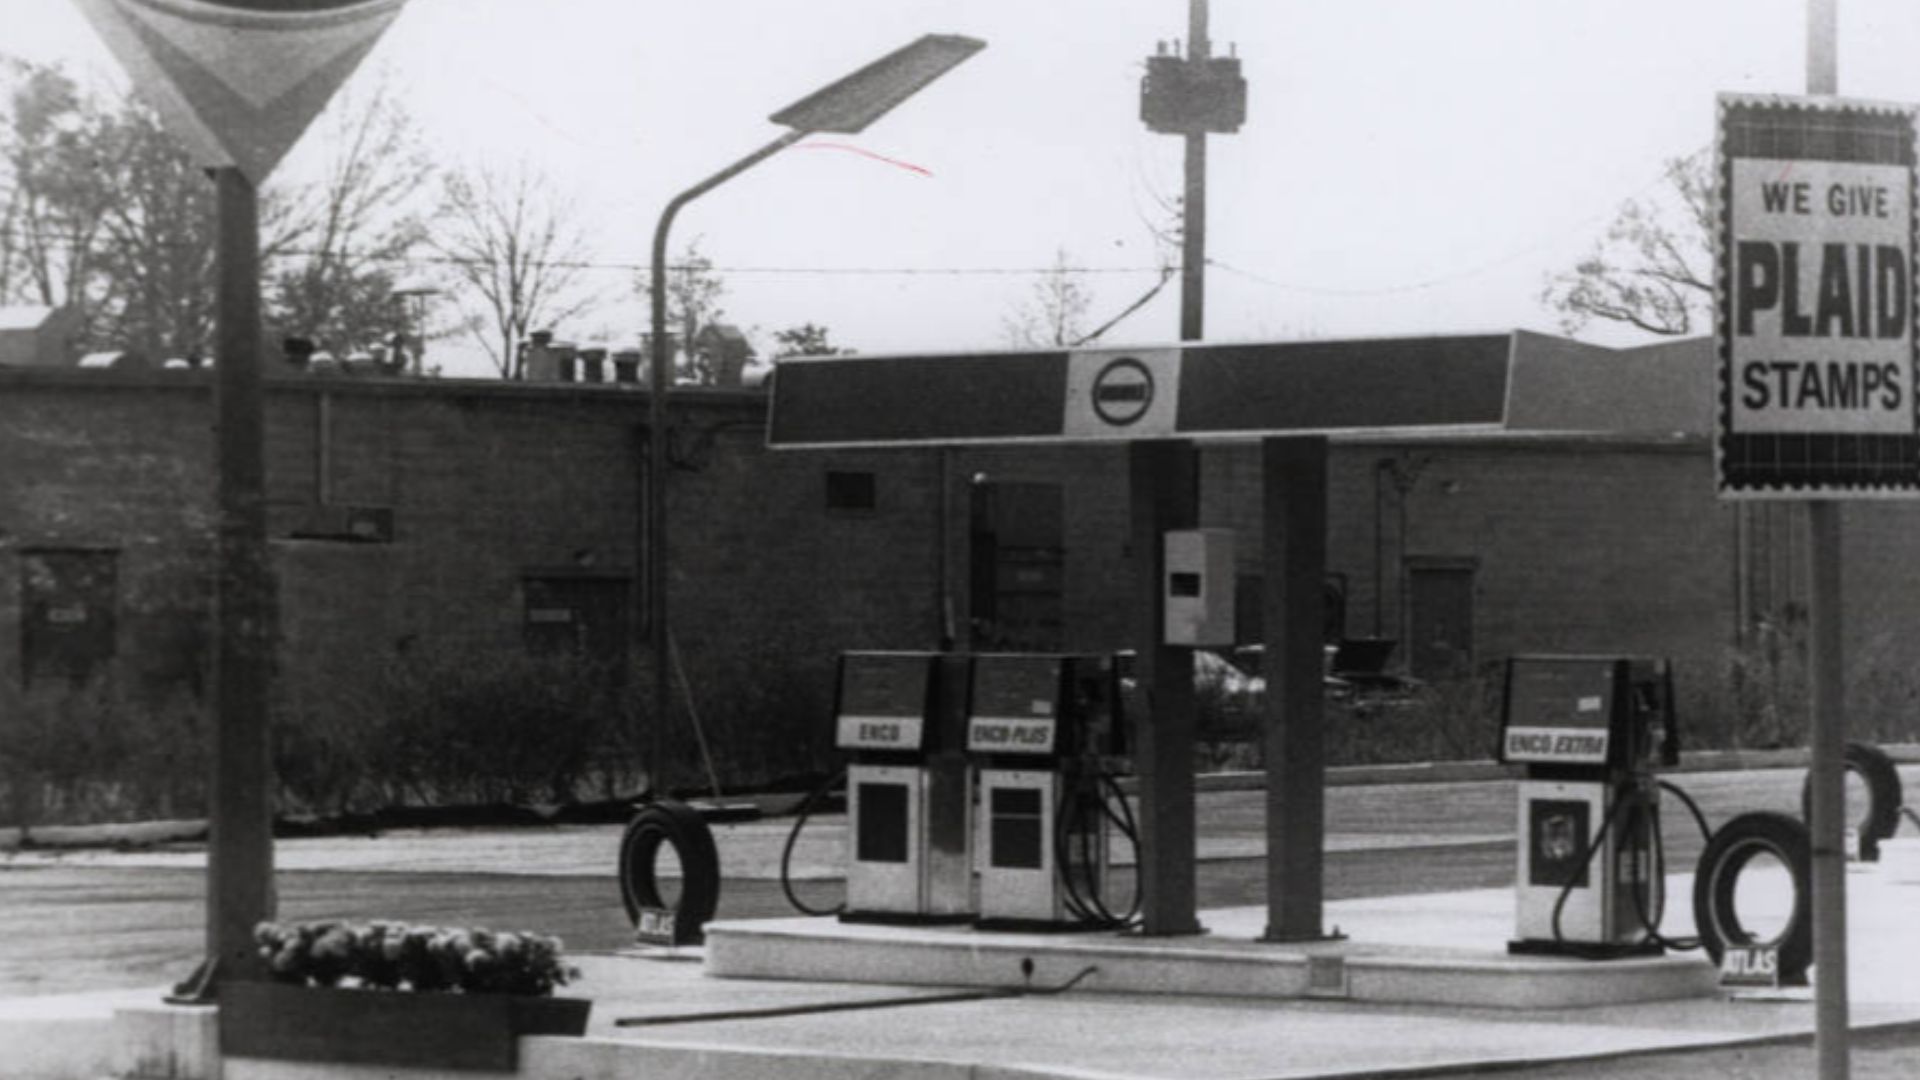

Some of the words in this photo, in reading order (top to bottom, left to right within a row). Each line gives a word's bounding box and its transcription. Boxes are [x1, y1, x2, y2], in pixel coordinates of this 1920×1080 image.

[1762, 181, 1811, 215] WE
[1827, 182, 1889, 219] GIVE
[1736, 239, 1907, 339] PLAID
[1742, 360, 1902, 411] STAMPS
[858, 723, 901, 742] ENCO
[972, 724, 1009, 743] ENCO
[1012, 725, 1050, 744] PLUS
[1509, 733, 1552, 754] ENCO
[1553, 735, 1604, 756] EXTRA
[1721, 949, 1777, 975] ATLAS
